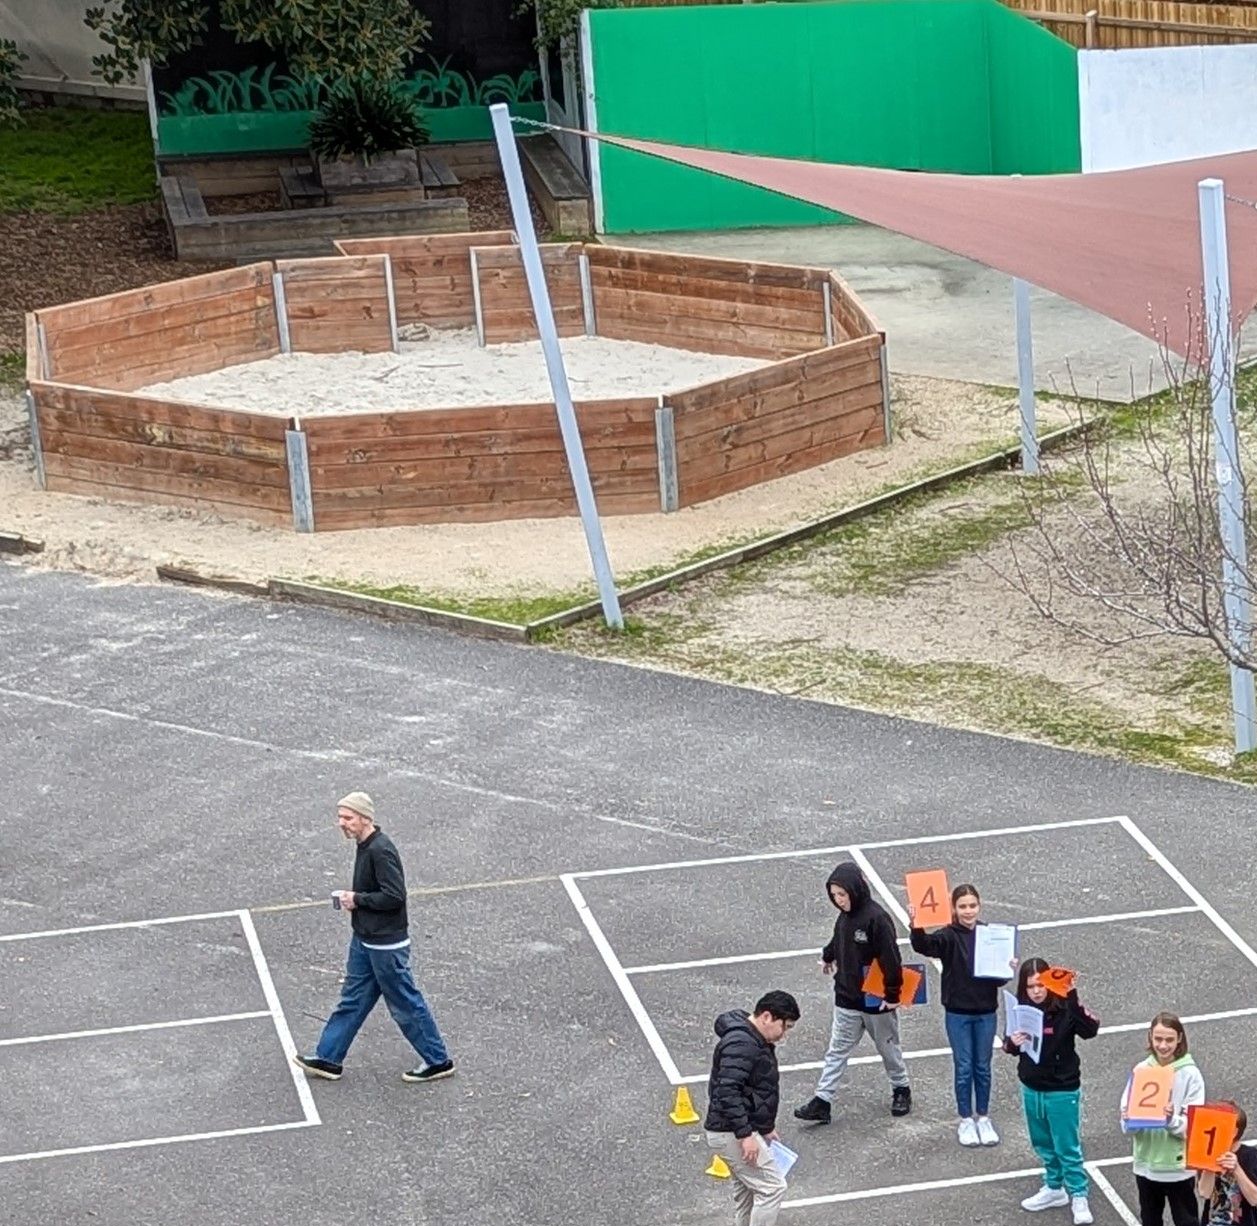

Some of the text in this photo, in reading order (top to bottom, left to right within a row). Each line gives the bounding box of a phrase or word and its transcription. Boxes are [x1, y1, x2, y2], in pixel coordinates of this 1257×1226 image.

[920, 886, 939, 913] 4
[1138, 1081, 1160, 1108] 2
[1204, 1126, 1217, 1156] 1
